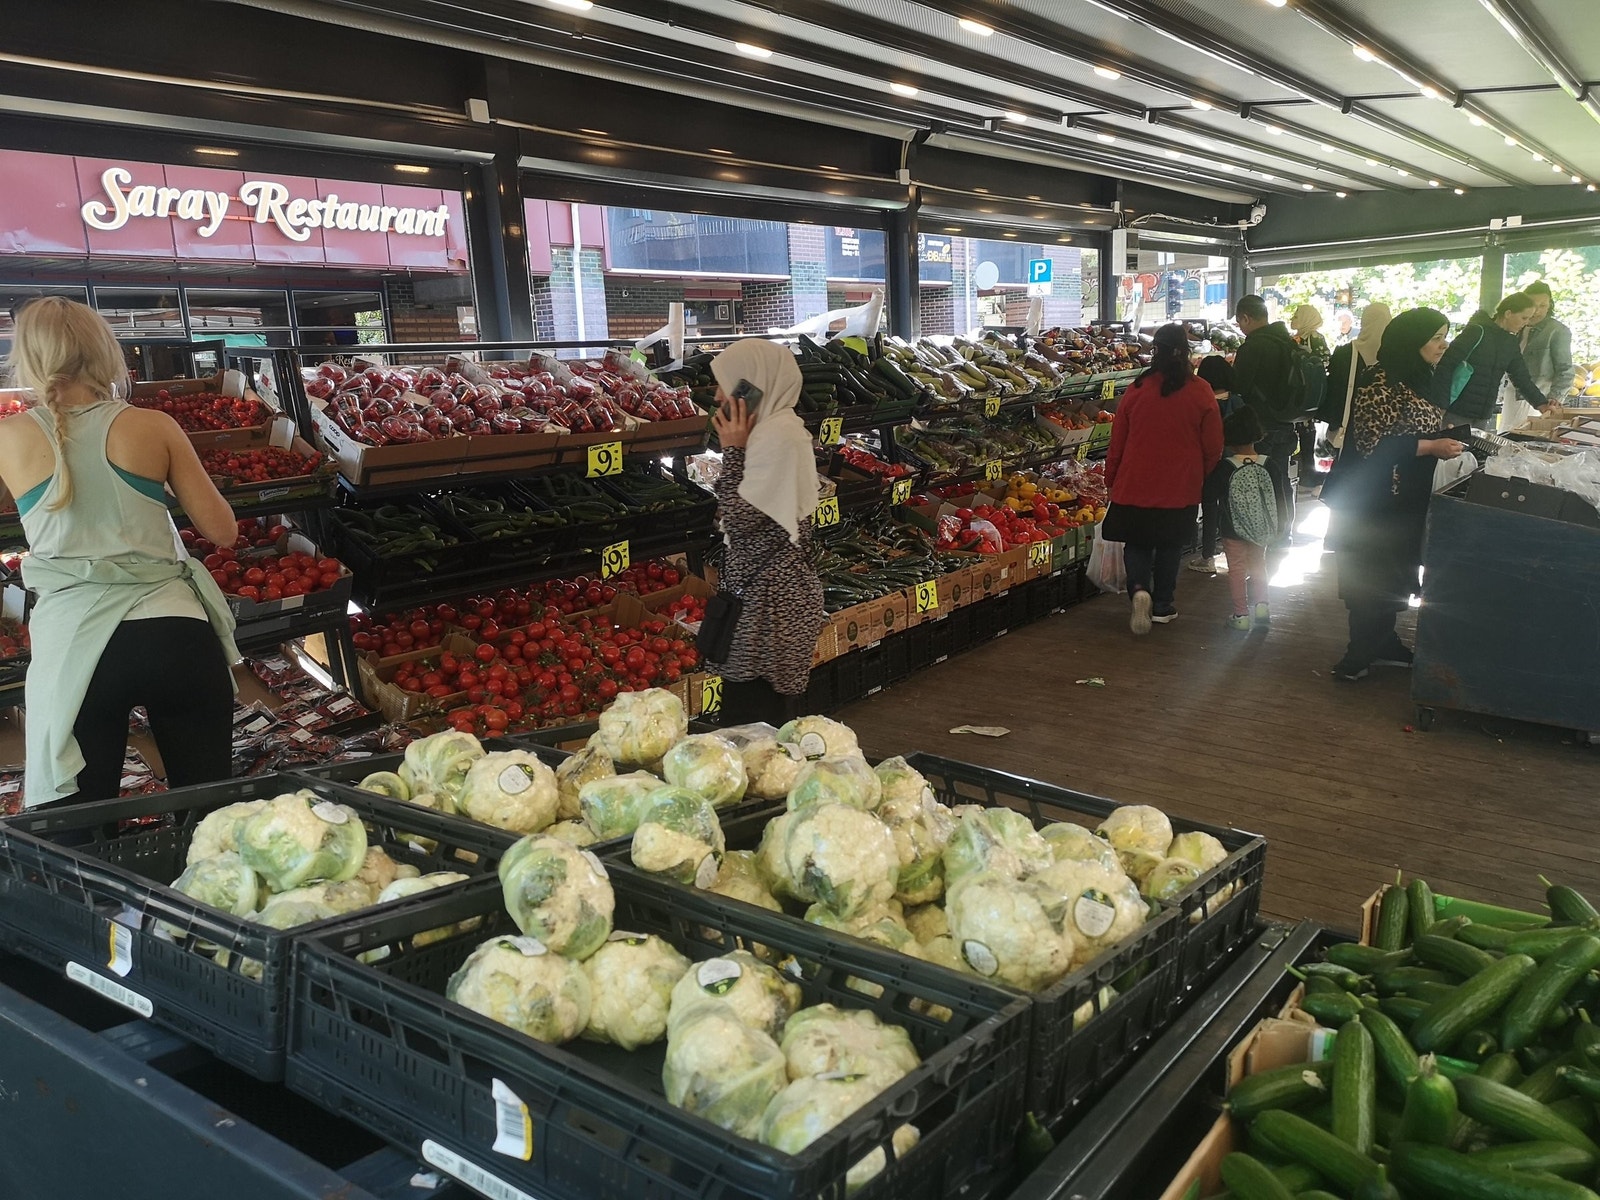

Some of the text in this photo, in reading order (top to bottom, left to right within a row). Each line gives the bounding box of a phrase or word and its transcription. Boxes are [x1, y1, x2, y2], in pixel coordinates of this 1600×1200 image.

[81, 167, 450, 242] Saray Restaurant
[1034, 261, 1048, 281] P
[593, 449, 612, 476] 9
[918, 588, 930, 612] 9
